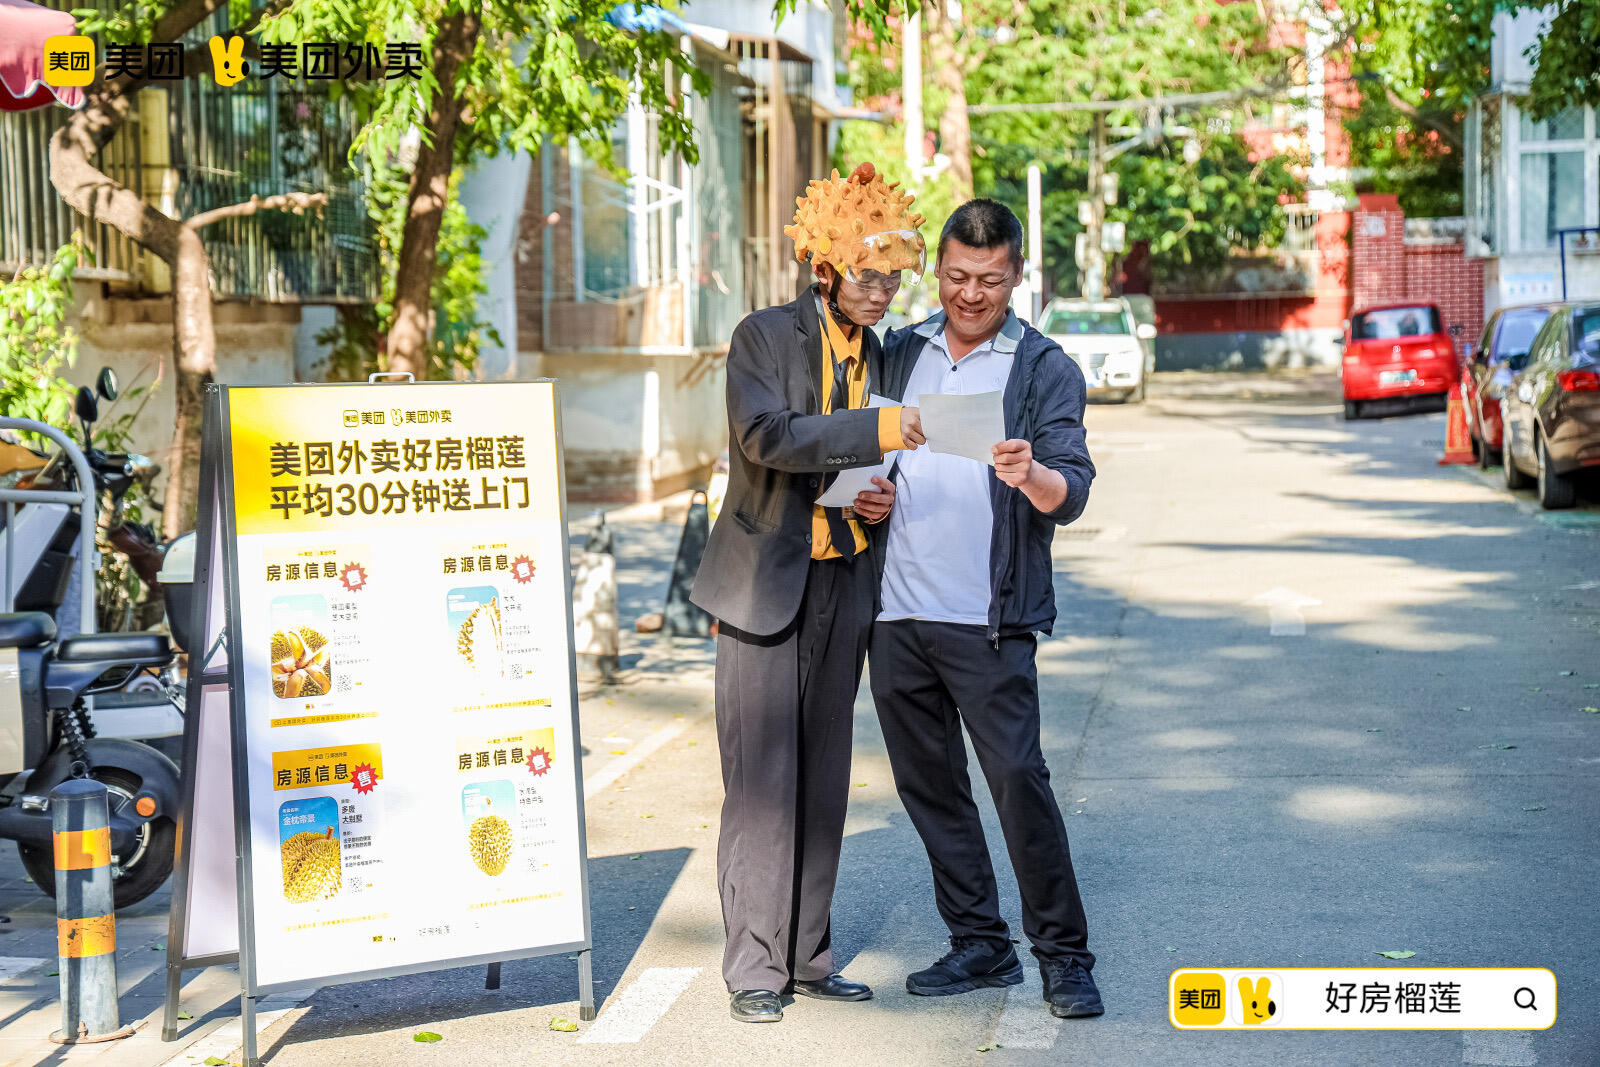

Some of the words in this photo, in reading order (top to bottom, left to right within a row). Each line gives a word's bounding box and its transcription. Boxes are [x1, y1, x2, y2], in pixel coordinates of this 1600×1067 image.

[361, 411, 385, 425] 美团
[405, 409, 452, 424] 美团外卖
[270, 435, 526, 478] 美团外卖好房榴莲
[270, 476, 530, 520] 平均30分钟送上门
[266, 561, 338, 582] 房源信息
[443, 554, 509, 574] 房源信息
[459, 747, 524, 770] 房源信息
[277, 763, 349, 787] 房源信息
